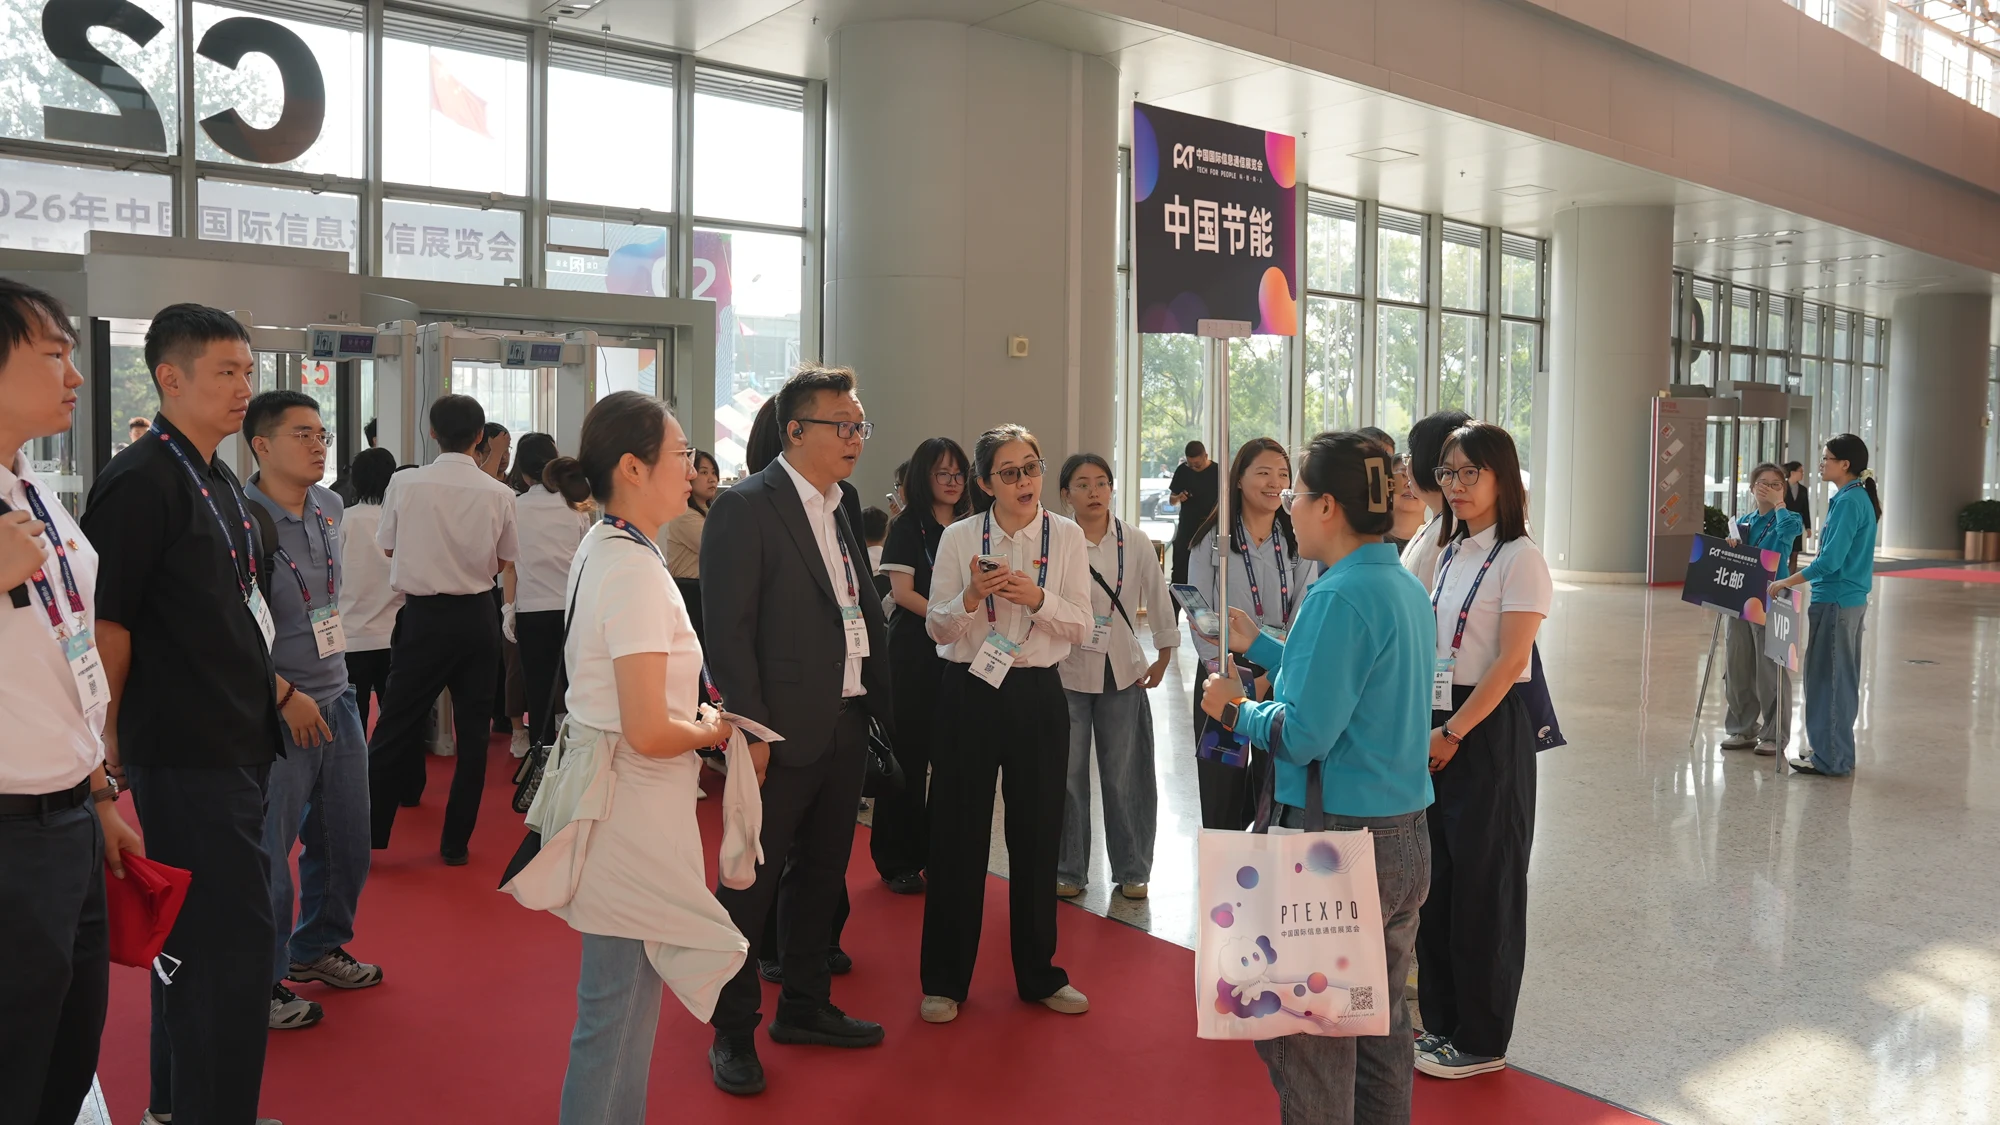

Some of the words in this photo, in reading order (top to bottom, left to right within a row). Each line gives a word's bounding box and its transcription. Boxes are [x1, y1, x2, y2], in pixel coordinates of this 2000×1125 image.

[1196, 147, 1264, 172] 中国国际信息通信展览会
[1196, 165, 1208, 174] TECH
[1209, 168, 1219, 177] FOR
[1220, 170, 1237, 179] PEOPLE
[1164, 194, 1274, 258] 中国节能
[1713, 566, 1745, 590] 北邮
[1774, 612, 1790, 641] VIP
[1281, 900, 1358, 925] PTEXPO
[1280, 924, 1360, 938] 中国国际信息通信展览会
